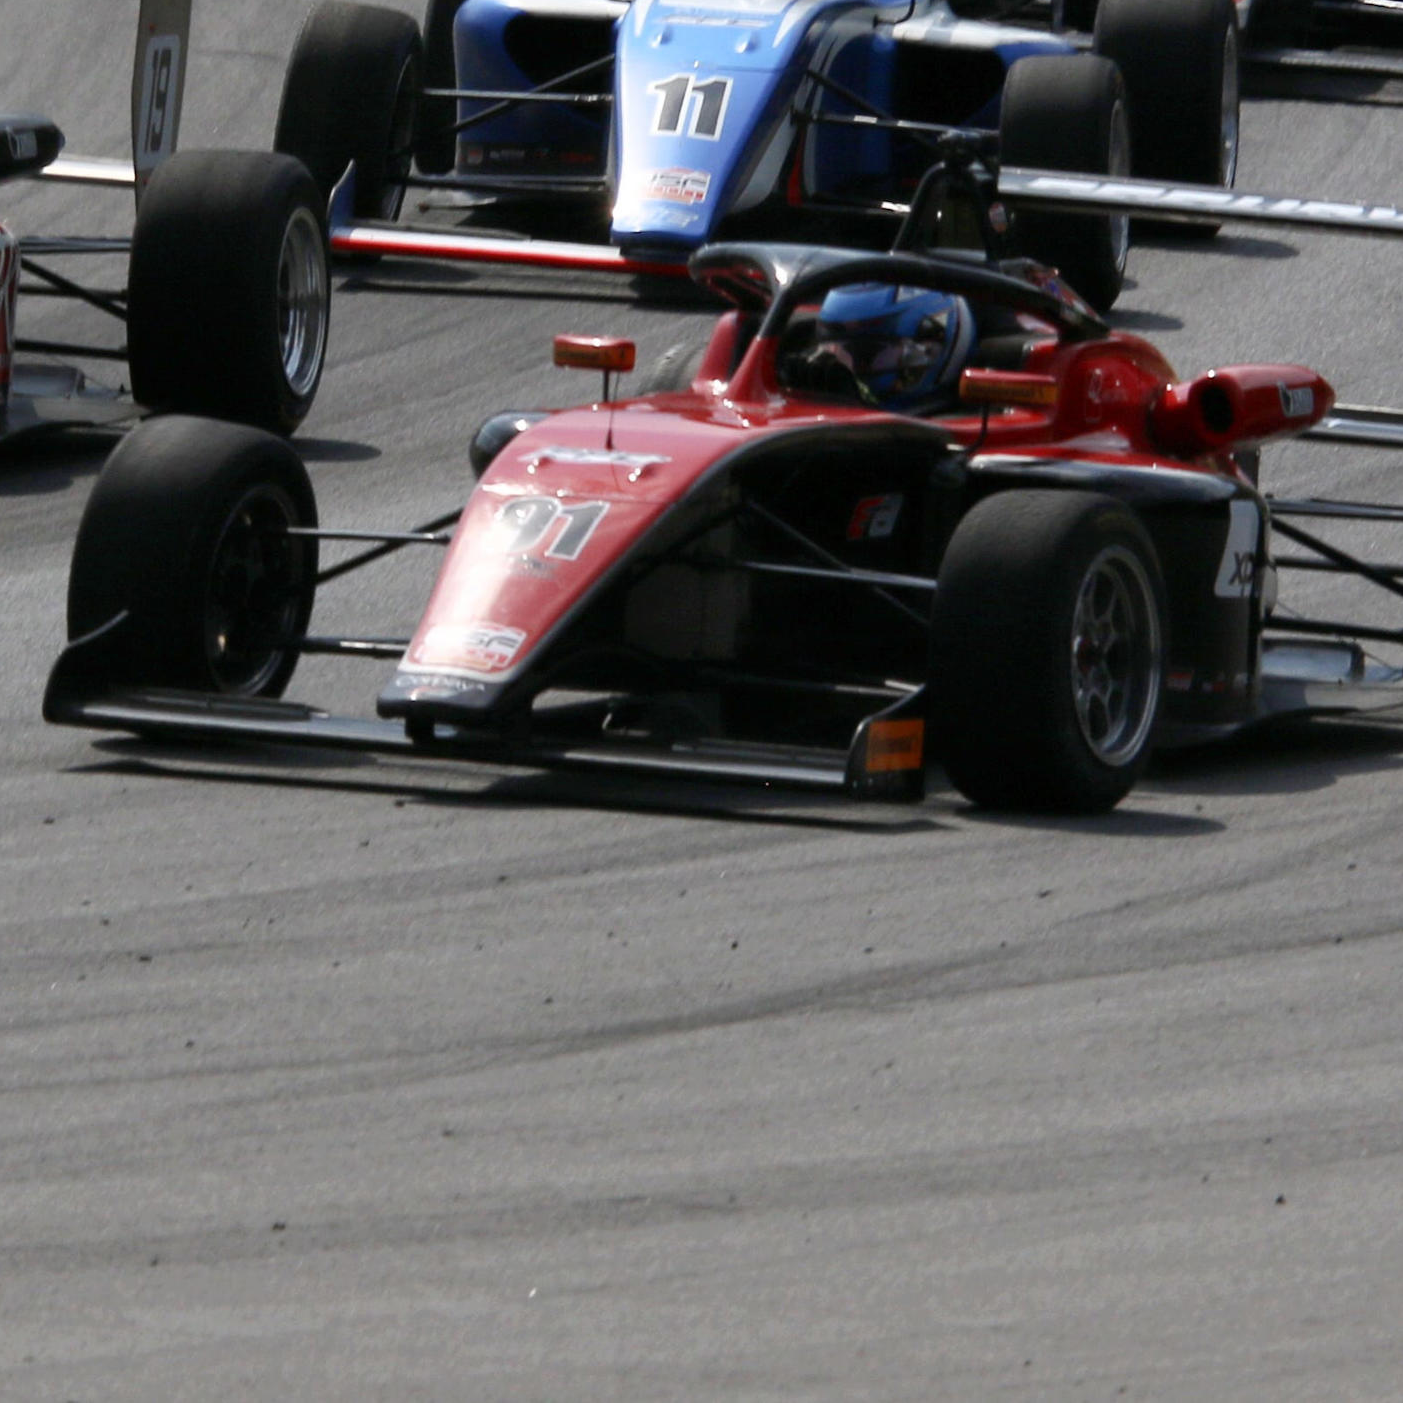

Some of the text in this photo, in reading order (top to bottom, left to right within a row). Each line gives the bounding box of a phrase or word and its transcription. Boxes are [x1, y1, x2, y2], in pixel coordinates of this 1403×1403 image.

[143, 47, 172, 154] 19
[646, 73, 734, 141] 11
[489, 495, 611, 562] 91
